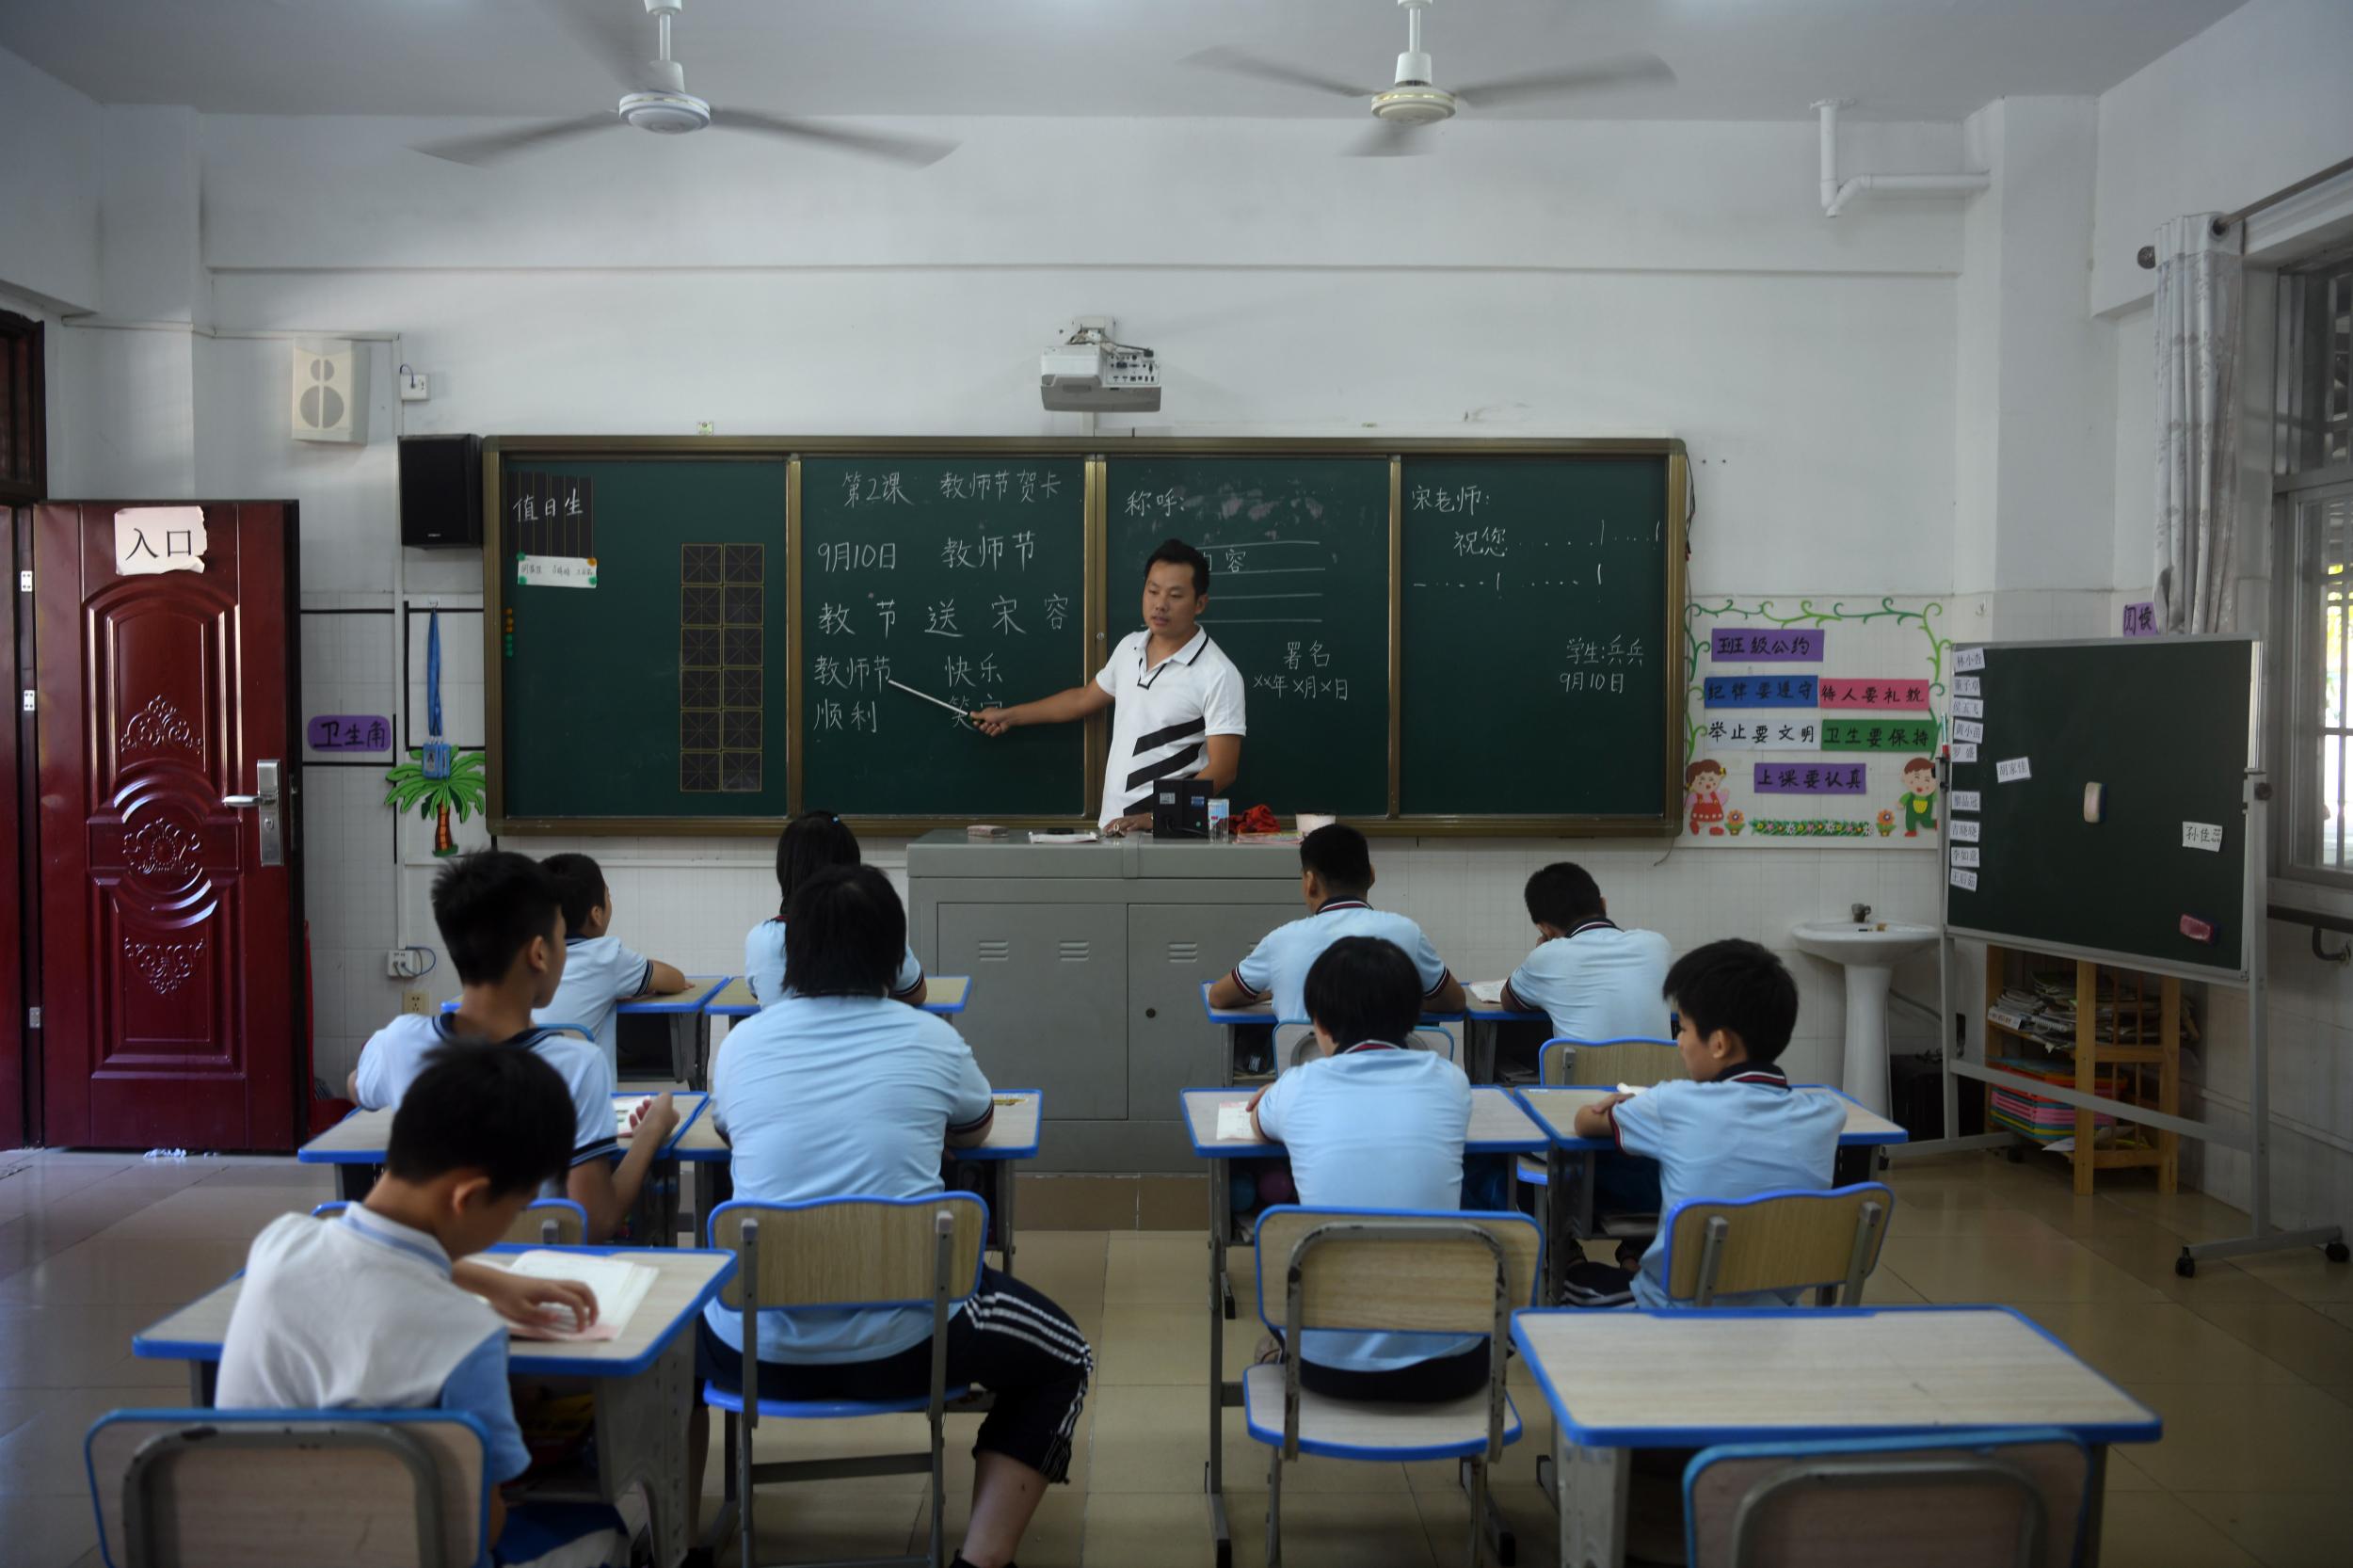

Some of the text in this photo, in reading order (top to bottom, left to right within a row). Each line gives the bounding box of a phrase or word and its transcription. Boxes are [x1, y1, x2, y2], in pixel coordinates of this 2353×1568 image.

[841, 470, 1062, 508] 第2课 教师节贺卡
[513, 488, 584, 522] 值日生
[125, 527, 193, 561] 入口
[817, 530, 1035, 573] 9月10日 教师节
[1283, 640, 1331, 671] 署名
[1717, 636, 1811, 656] 班级公约
[813, 652, 1004, 694] 教师节 快乐
[1559, 671, 1625, 695] 9月10日
[1707, 680, 1925, 704] 纪律要遵守 待人要礼貌
[813, 697, 878, 733] 顺利
[312, 719, 386, 749] 卫生角
[1708, 720, 1929, 747] 举止要文明 卫生要保持
[1757, 767, 1863, 790] 上课要认真
